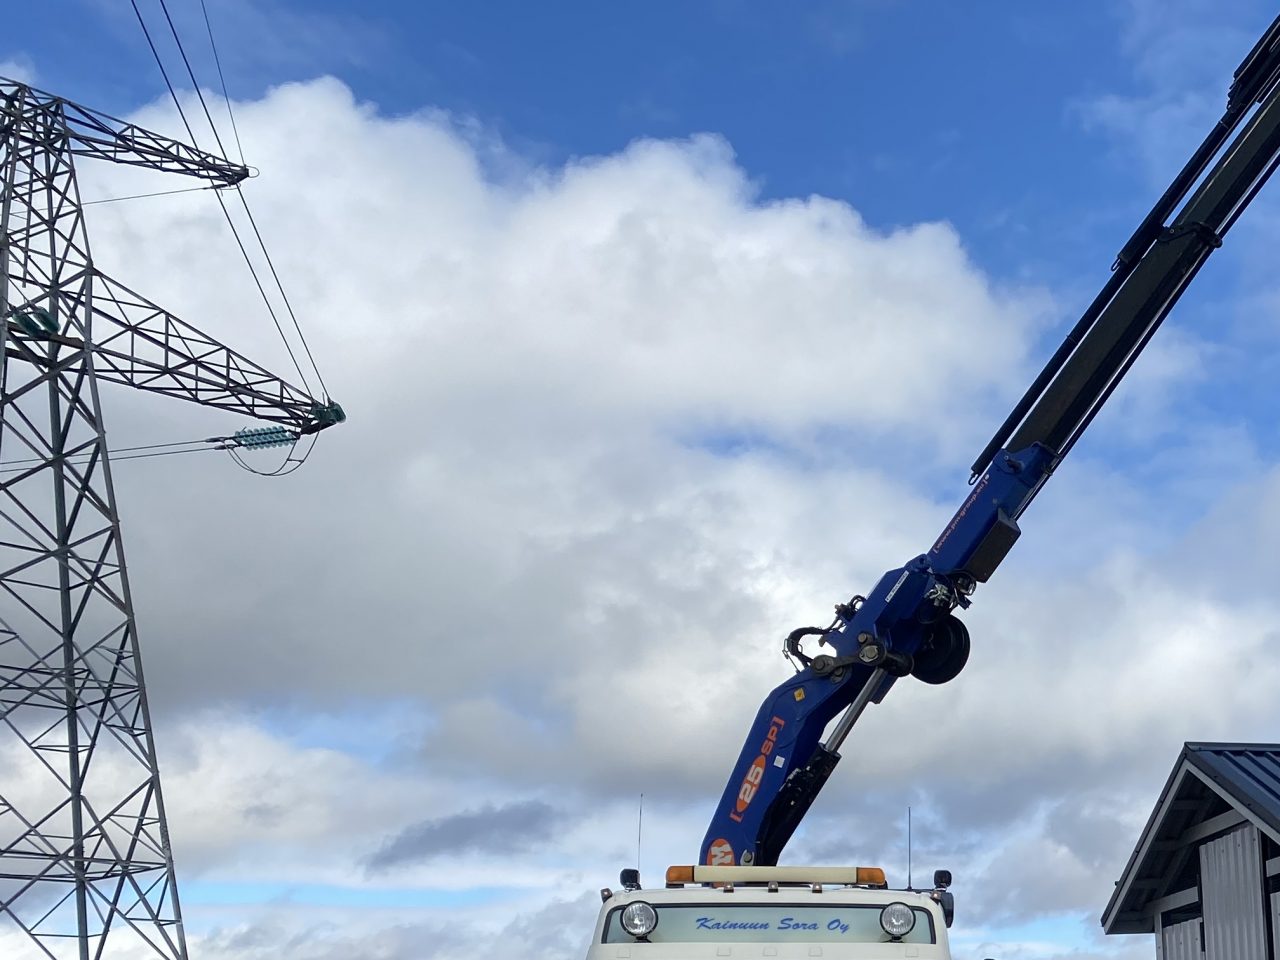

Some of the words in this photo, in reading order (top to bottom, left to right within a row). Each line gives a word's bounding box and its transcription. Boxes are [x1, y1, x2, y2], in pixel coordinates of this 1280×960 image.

[695, 917, 770, 931] Kainuun
[777, 917, 820, 931] Sora
[827, 918, 850, 934] Oy
